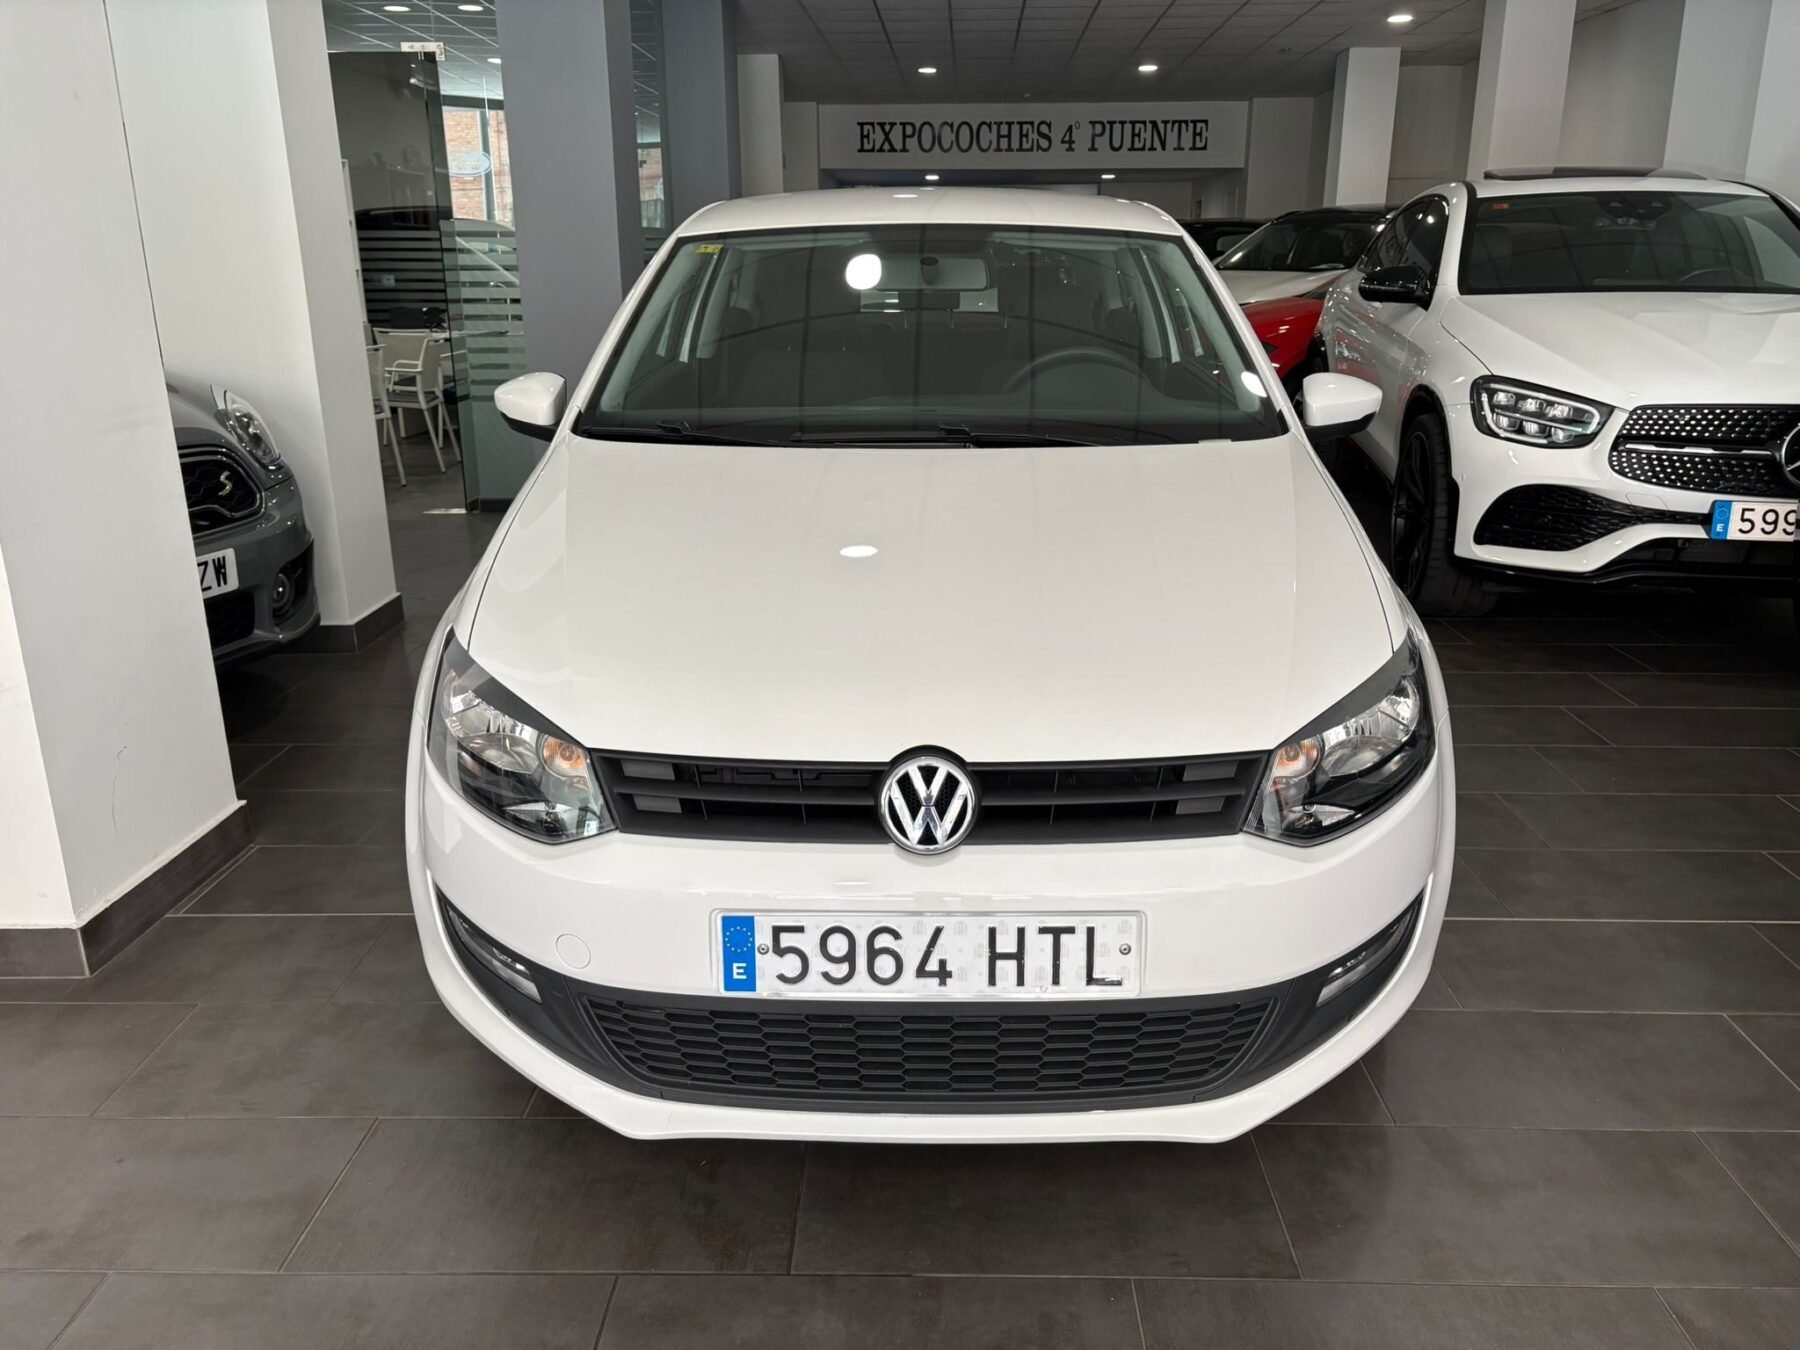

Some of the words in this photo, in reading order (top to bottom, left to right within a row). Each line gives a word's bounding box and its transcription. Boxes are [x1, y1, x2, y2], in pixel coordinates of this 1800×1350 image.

[857, 120, 1052, 153] EXPOCOCHES
[1088, 119, 1209, 152] PUENTE
[1716, 523, 1725, 532] E
[771, 925, 953, 987] 5964
[987, 925, 1123, 987] HTL
[732, 962, 748, 980] E
